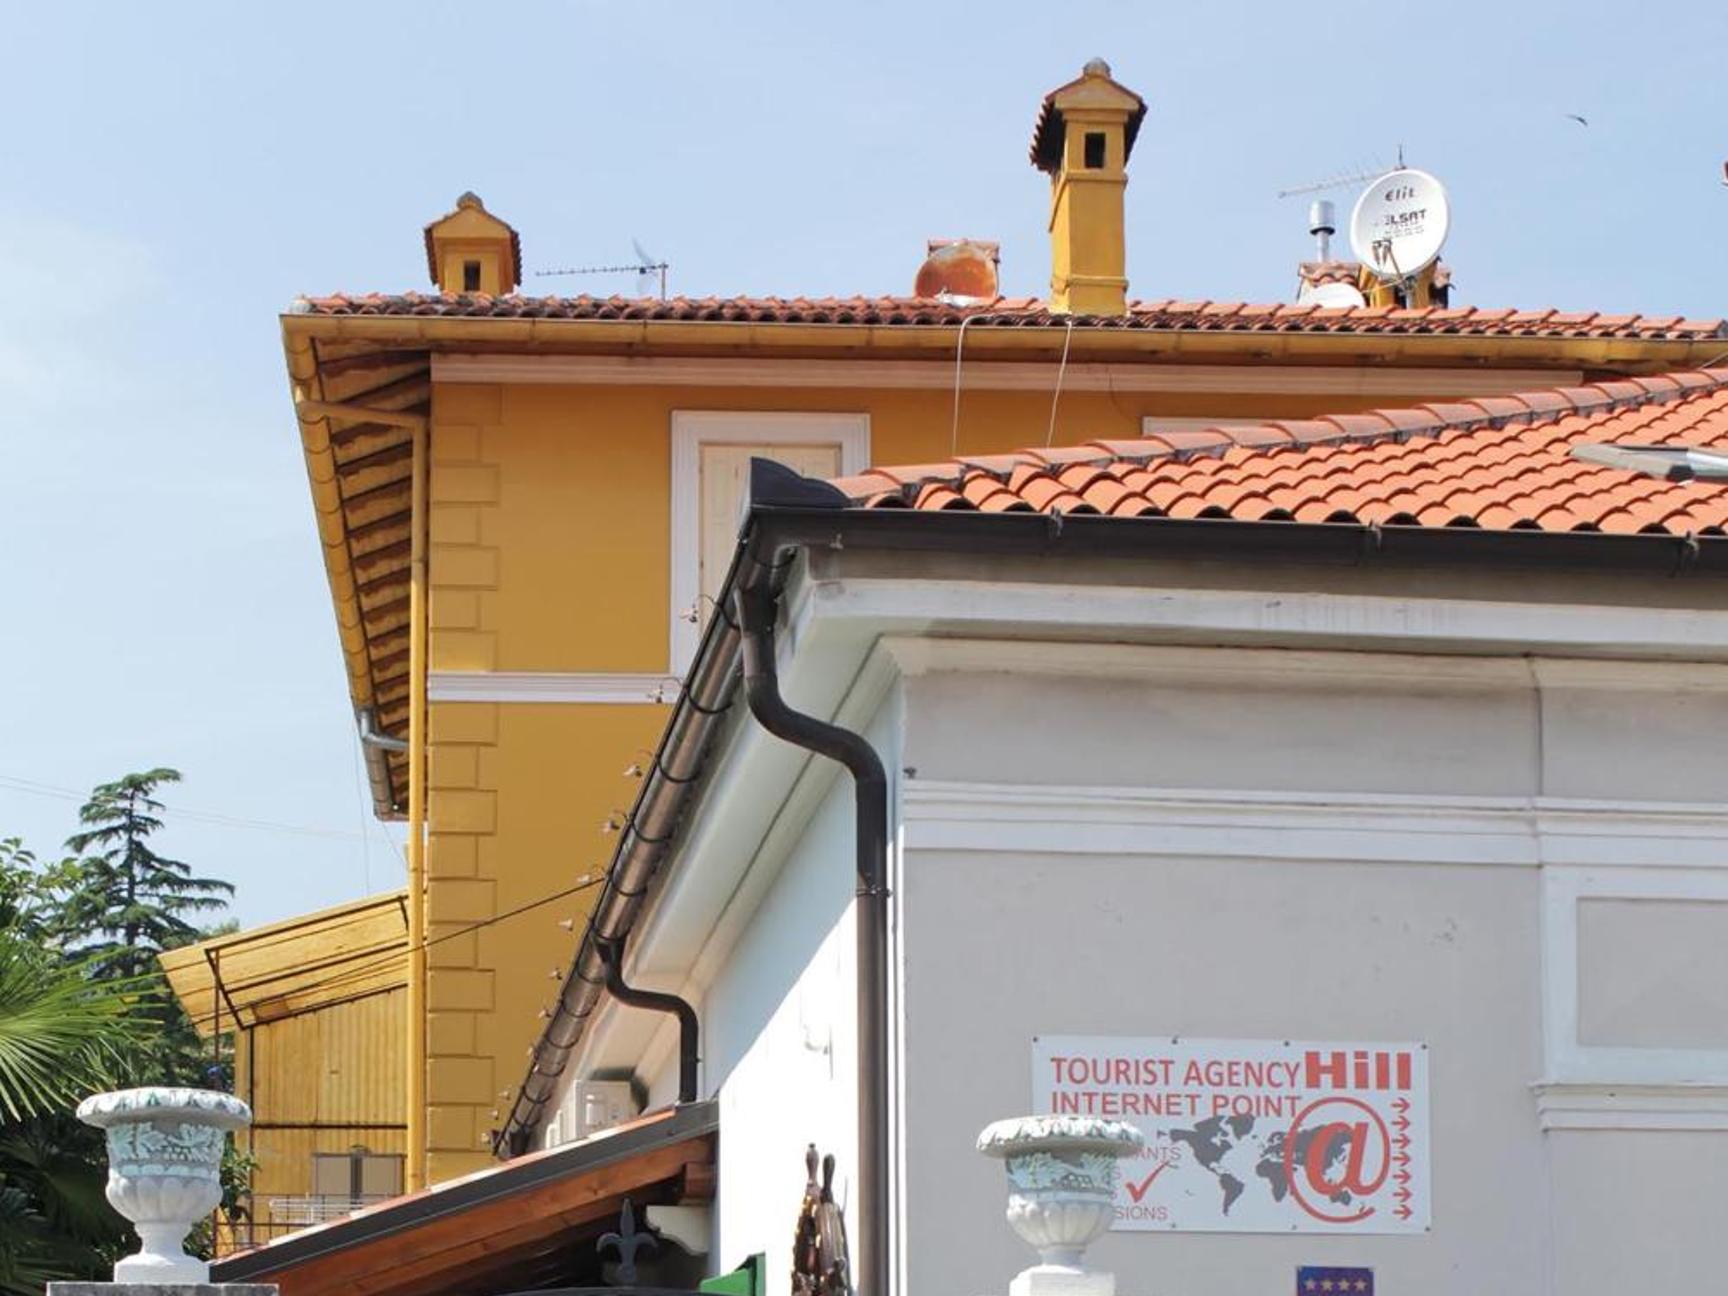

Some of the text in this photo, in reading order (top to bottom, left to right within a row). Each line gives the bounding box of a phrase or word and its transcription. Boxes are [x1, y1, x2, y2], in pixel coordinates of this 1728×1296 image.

[1050, 1056, 1301, 1089] TOURIST AGENCY
[1304, 1050, 1412, 1091] Hill
[1051, 1091, 1303, 1118] INTERNET POINT
[1112, 1205, 1169, 1221] SIONS
